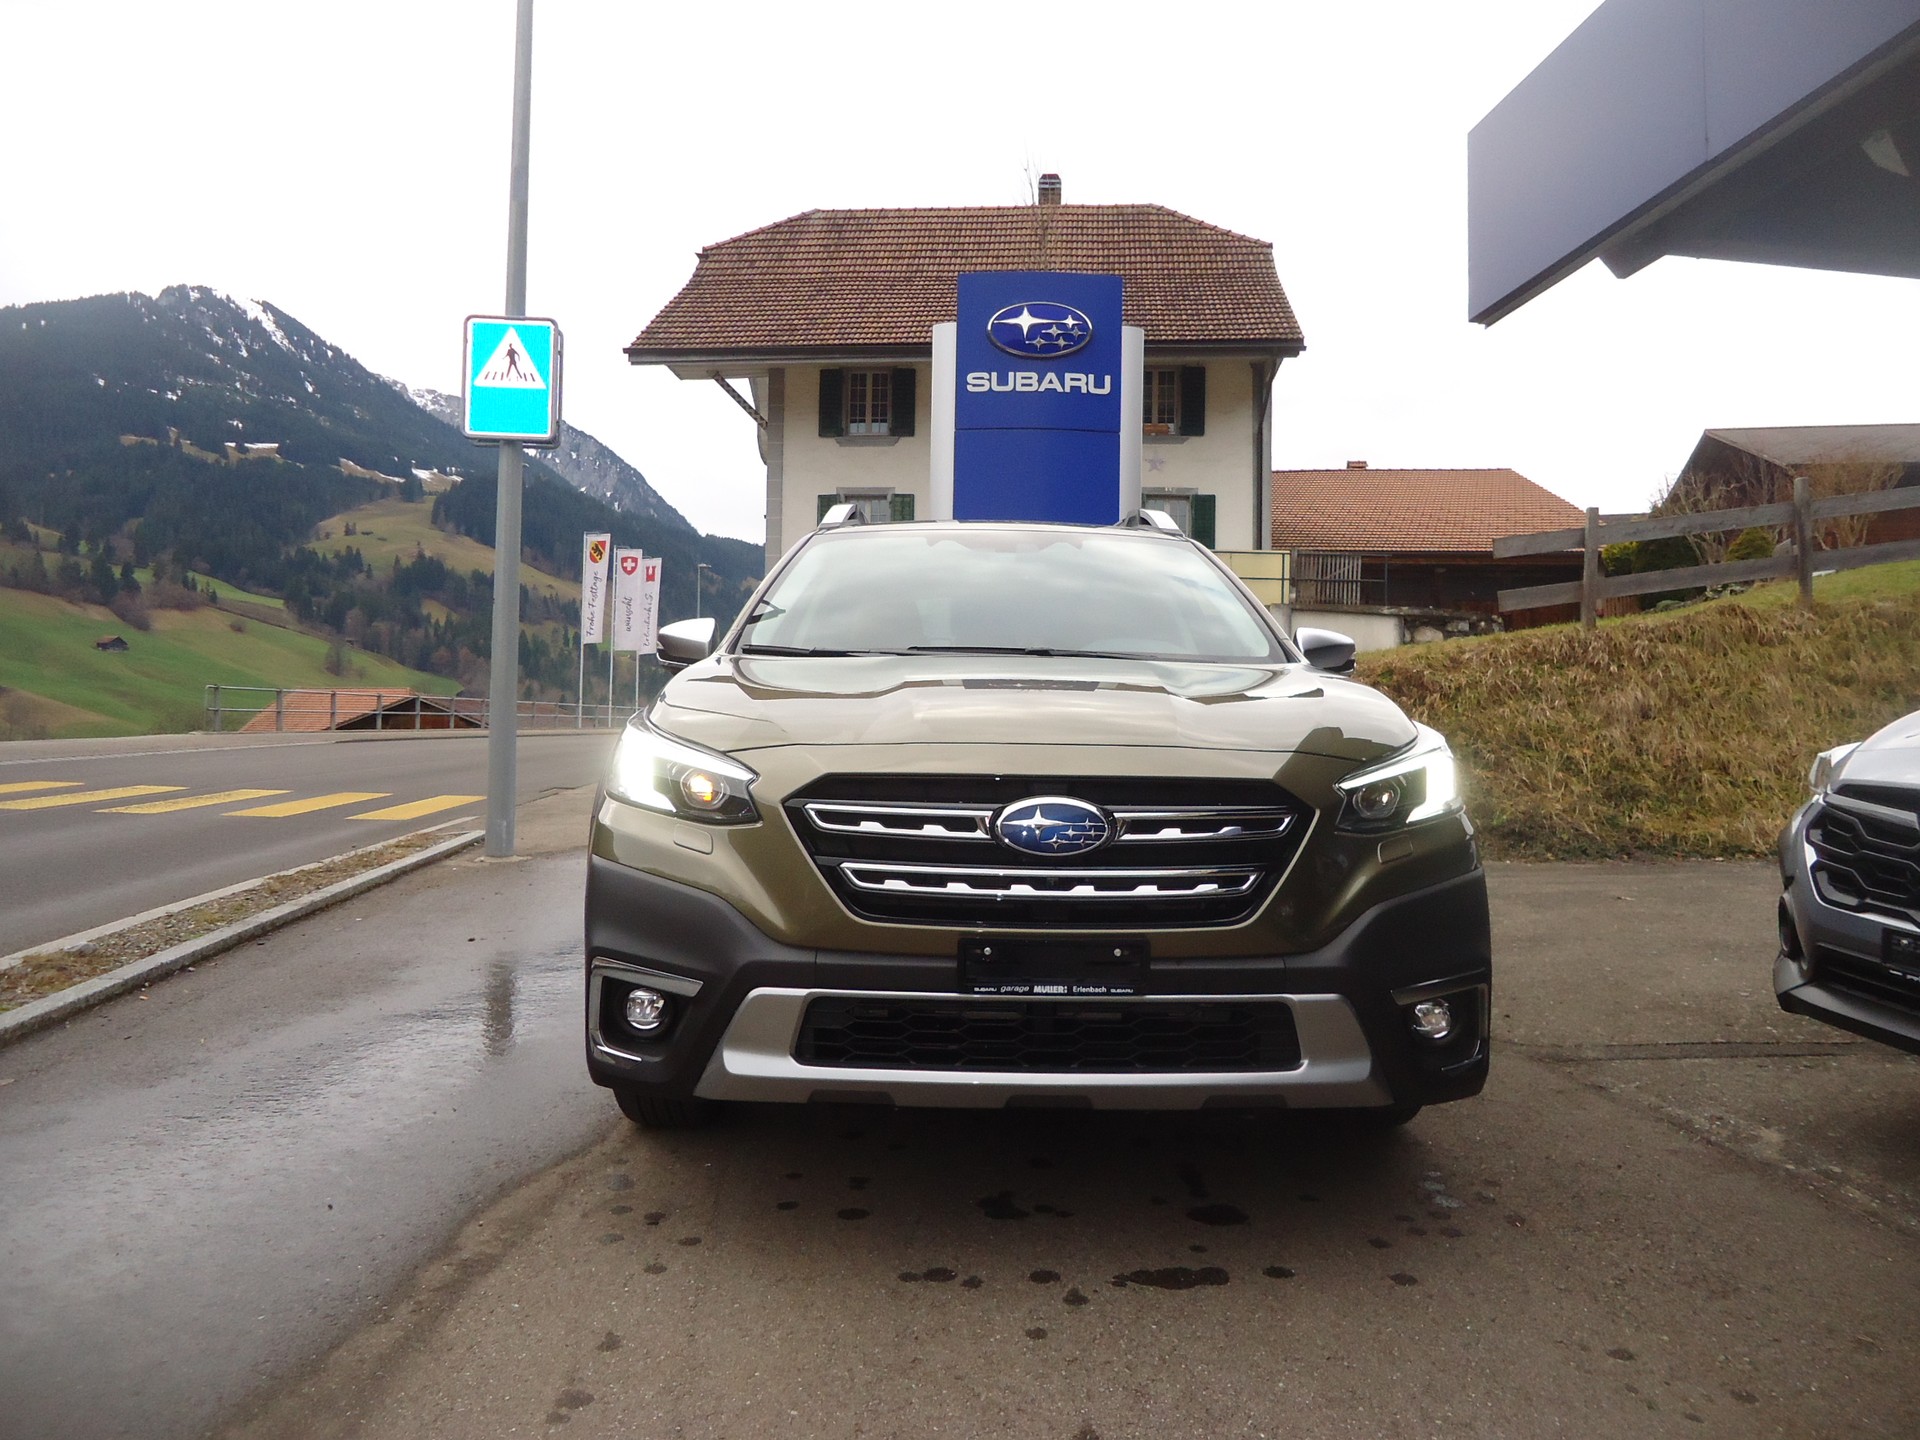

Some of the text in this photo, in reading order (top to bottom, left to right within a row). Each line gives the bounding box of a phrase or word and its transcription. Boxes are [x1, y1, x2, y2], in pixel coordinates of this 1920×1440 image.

[966, 371, 1112, 395] SUBARU
[586, 570, 602, 637] Frohe Festtage
[1000, 985, 1030, 993] garage
[1072, 985, 1107, 993] Erlenbach
